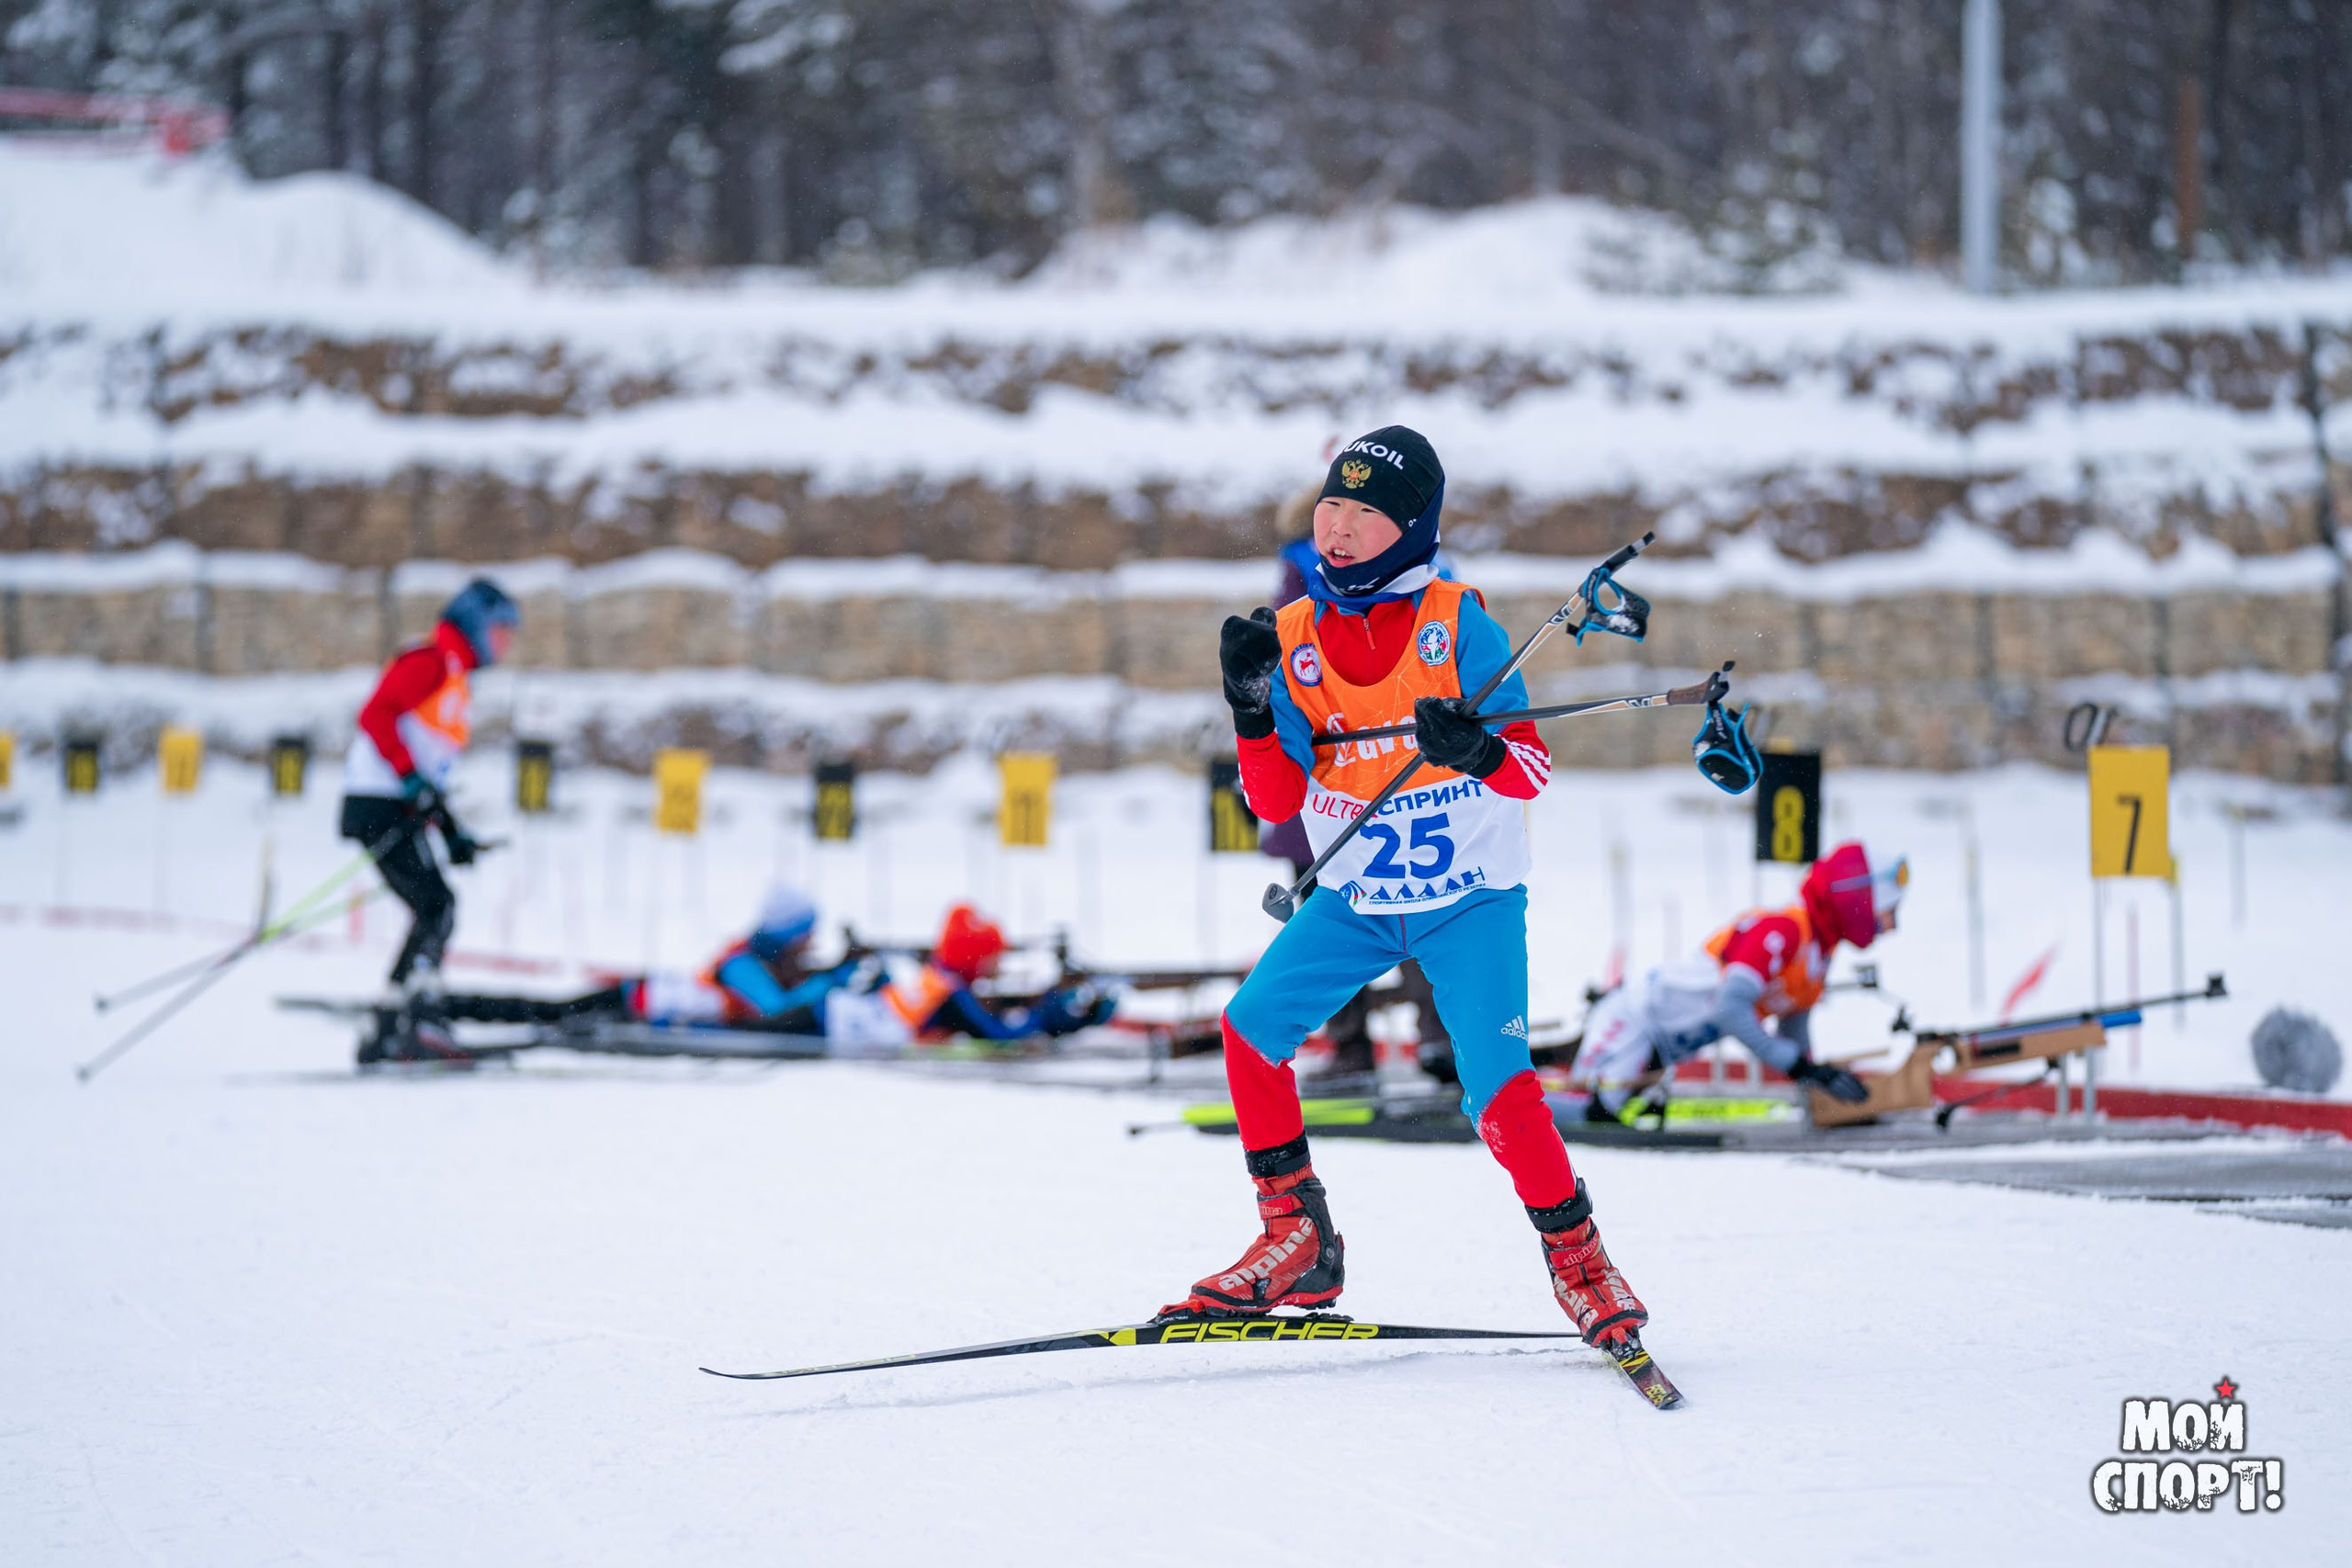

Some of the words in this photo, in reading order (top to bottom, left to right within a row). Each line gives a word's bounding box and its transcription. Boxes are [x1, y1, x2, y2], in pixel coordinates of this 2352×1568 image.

[1342, 440, 1405, 470] UKOIL
[1312, 794, 1378, 821] ULTR
[1772, 785, 1805, 862] 8
[2117, 795, 2143, 874] 7
[1360, 812, 1455, 880] 25
[1218, 1216, 1315, 1291] alpina
[1159, 1321, 1379, 1344] FISCHER
